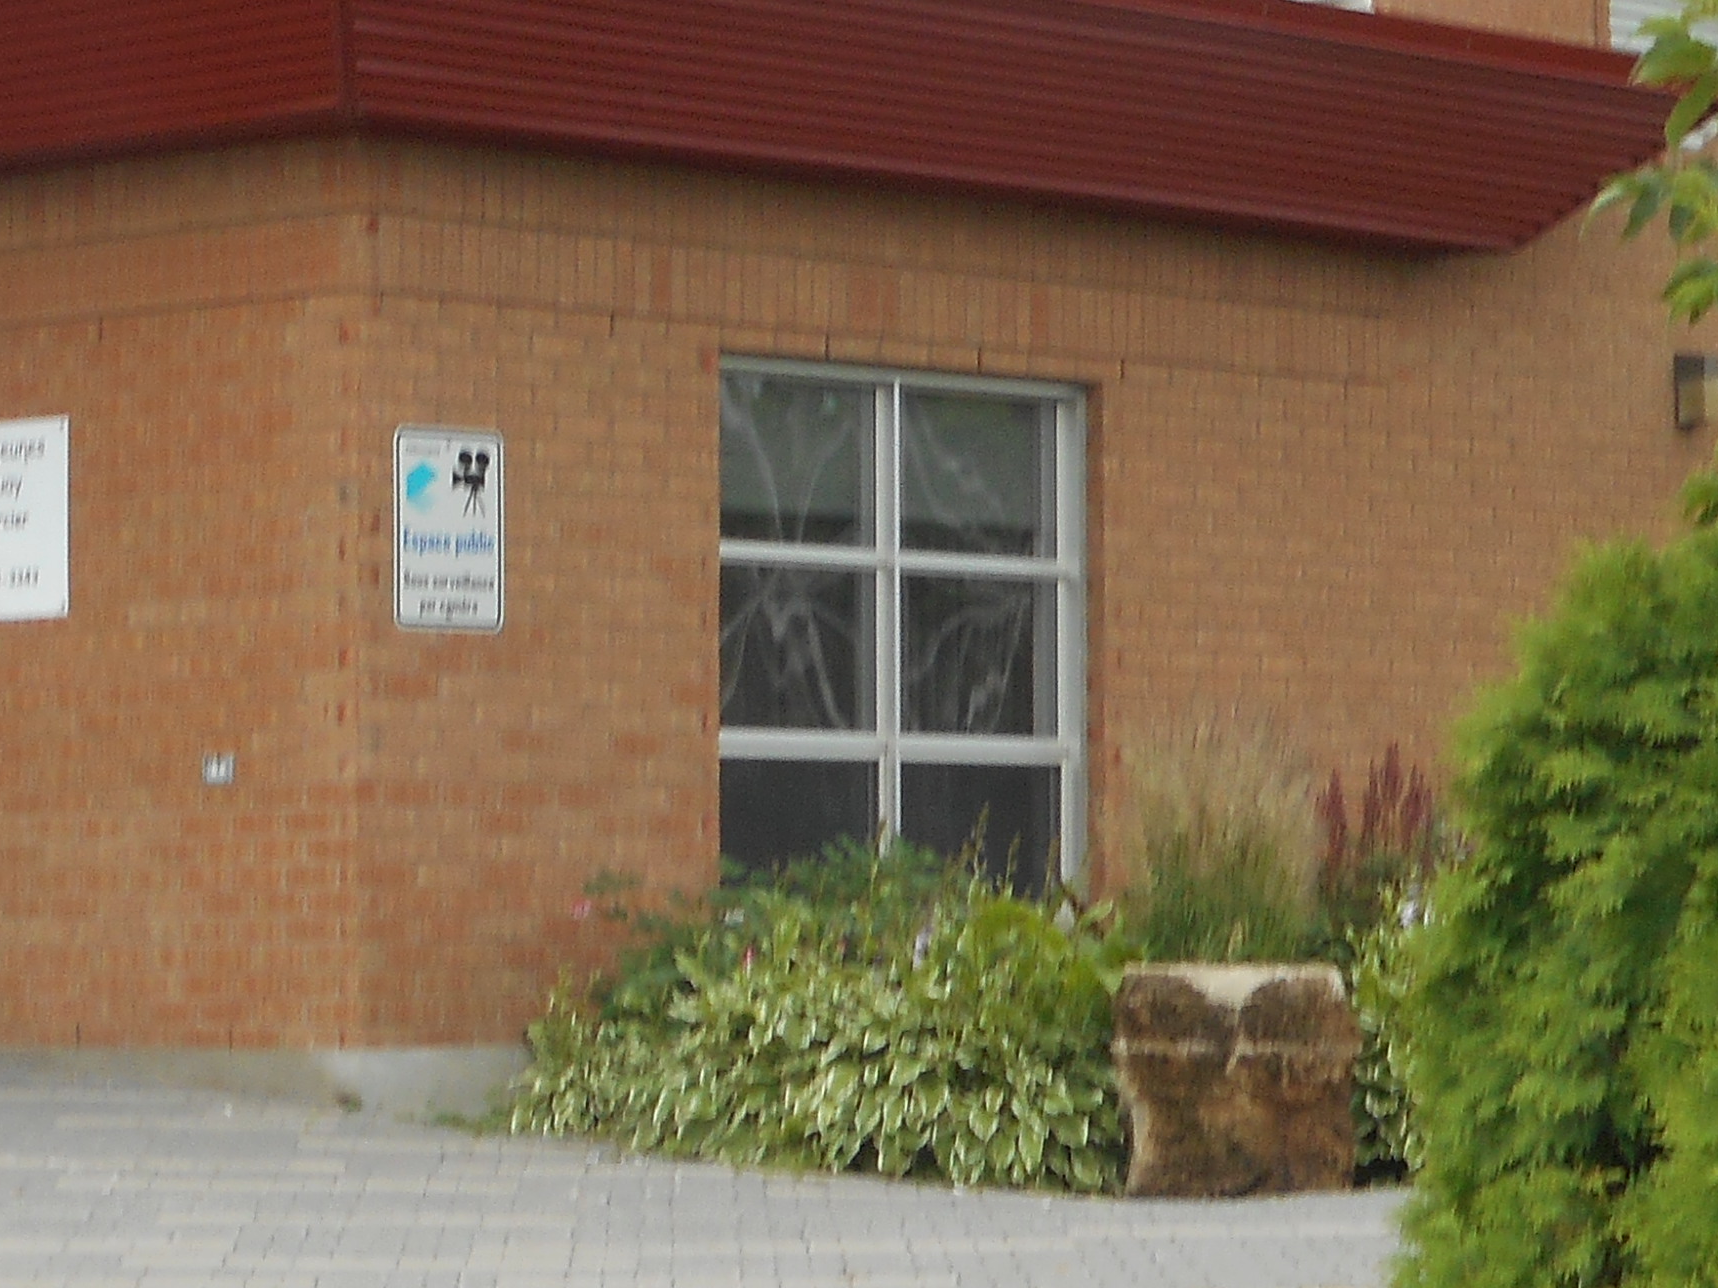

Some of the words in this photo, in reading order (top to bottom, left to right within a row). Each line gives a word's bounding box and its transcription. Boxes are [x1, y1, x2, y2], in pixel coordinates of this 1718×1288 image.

[403, 527, 450, 556] Espace
[455, 527, 495, 558] public
[419, 599, 436, 618] par
